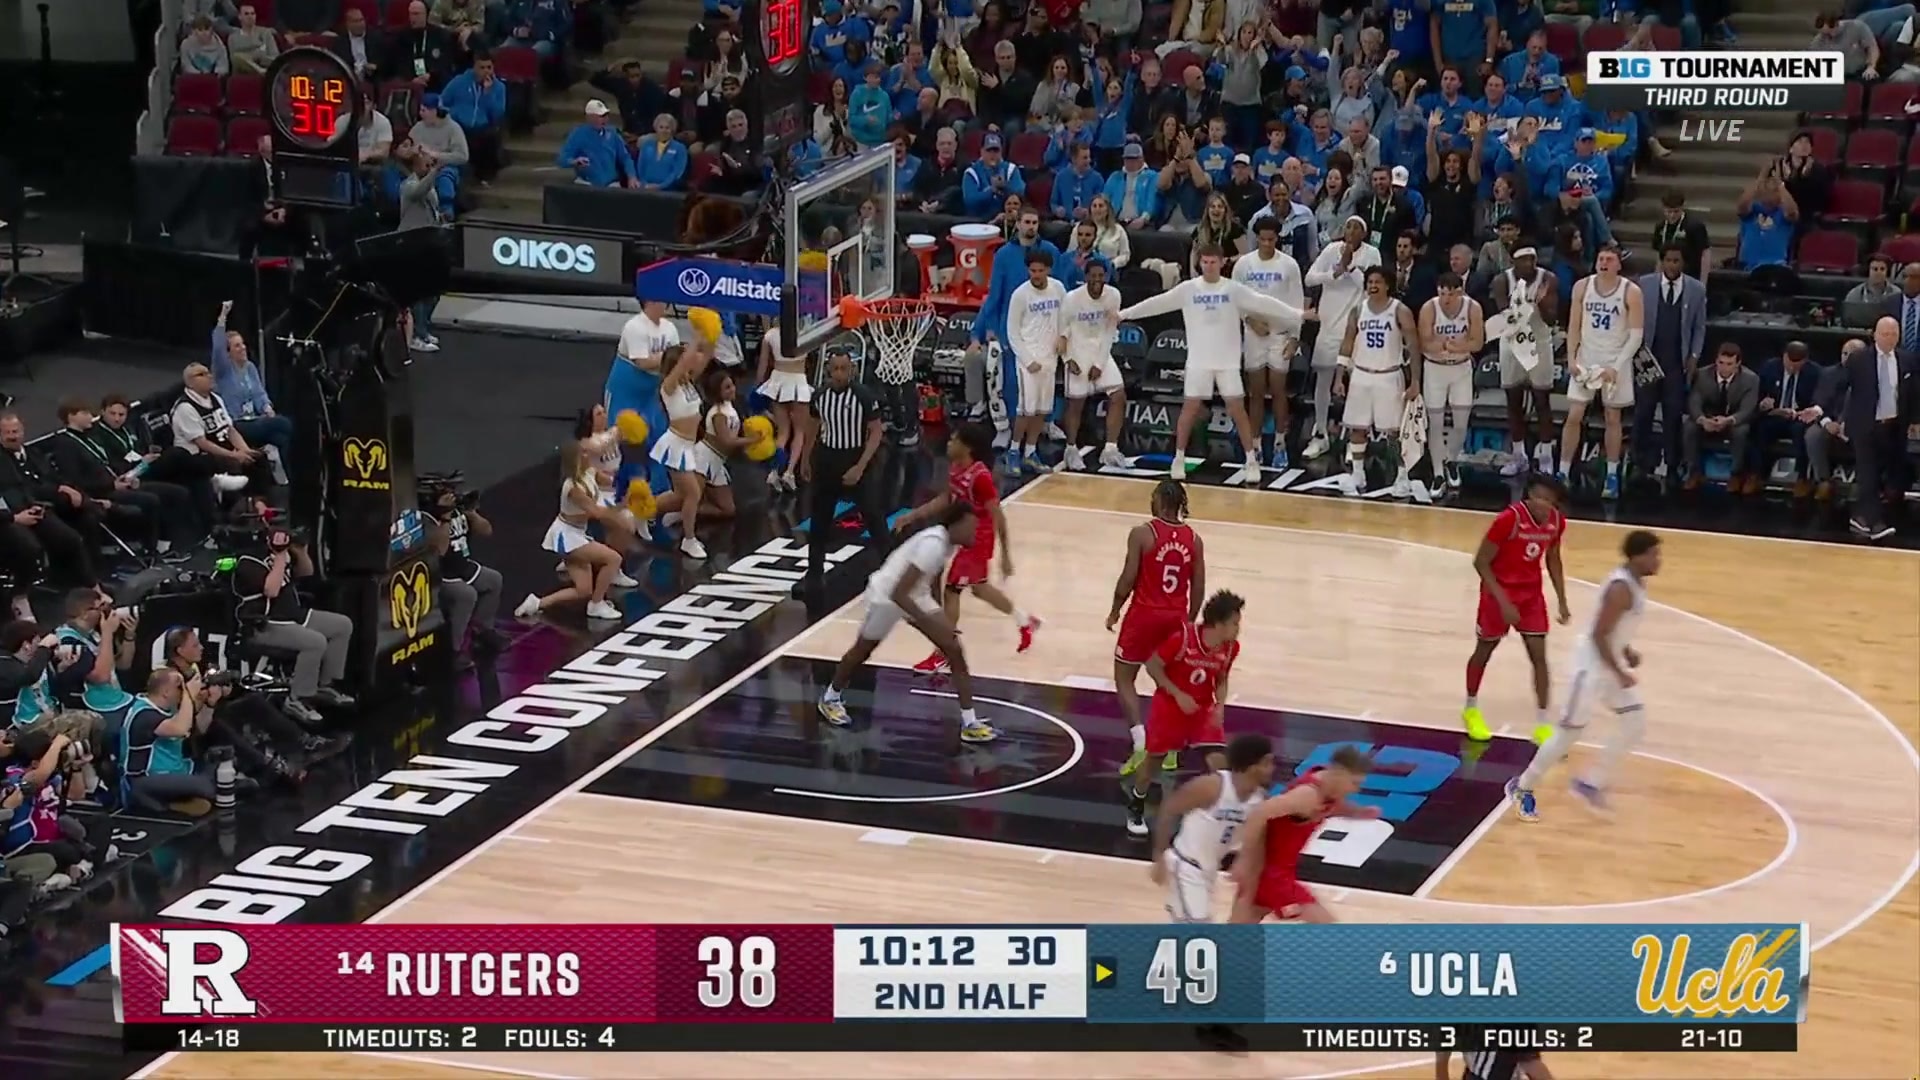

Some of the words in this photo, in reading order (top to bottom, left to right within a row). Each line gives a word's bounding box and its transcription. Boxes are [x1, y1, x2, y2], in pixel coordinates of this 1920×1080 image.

[766, 0, 801, 64] 30
[290, 76, 343, 103] 10:12
[291, 103, 335, 135] 30
[492, 236, 596, 274] OIKOS
[960, 248, 977, 268] G
[711, 276, 782, 301] Allstate
[1586, 302, 1620, 317] UCLA
[1360, 319, 1392, 332] UCLA
[1436, 325, 1469, 335] UCLA
[1592, 313, 1610, 330] 34
[1366, 332, 1385, 348] 55
[343, 479, 390, 491] RAM
[1523, 542, 1540, 561] 9
[1162, 565, 1180, 593] 5
[391, 633, 434, 666] RAM
[1190, 669, 1206, 685] 0
[157, 846, 373, 924] BIG
[295, 755, 519, 835] TEN
